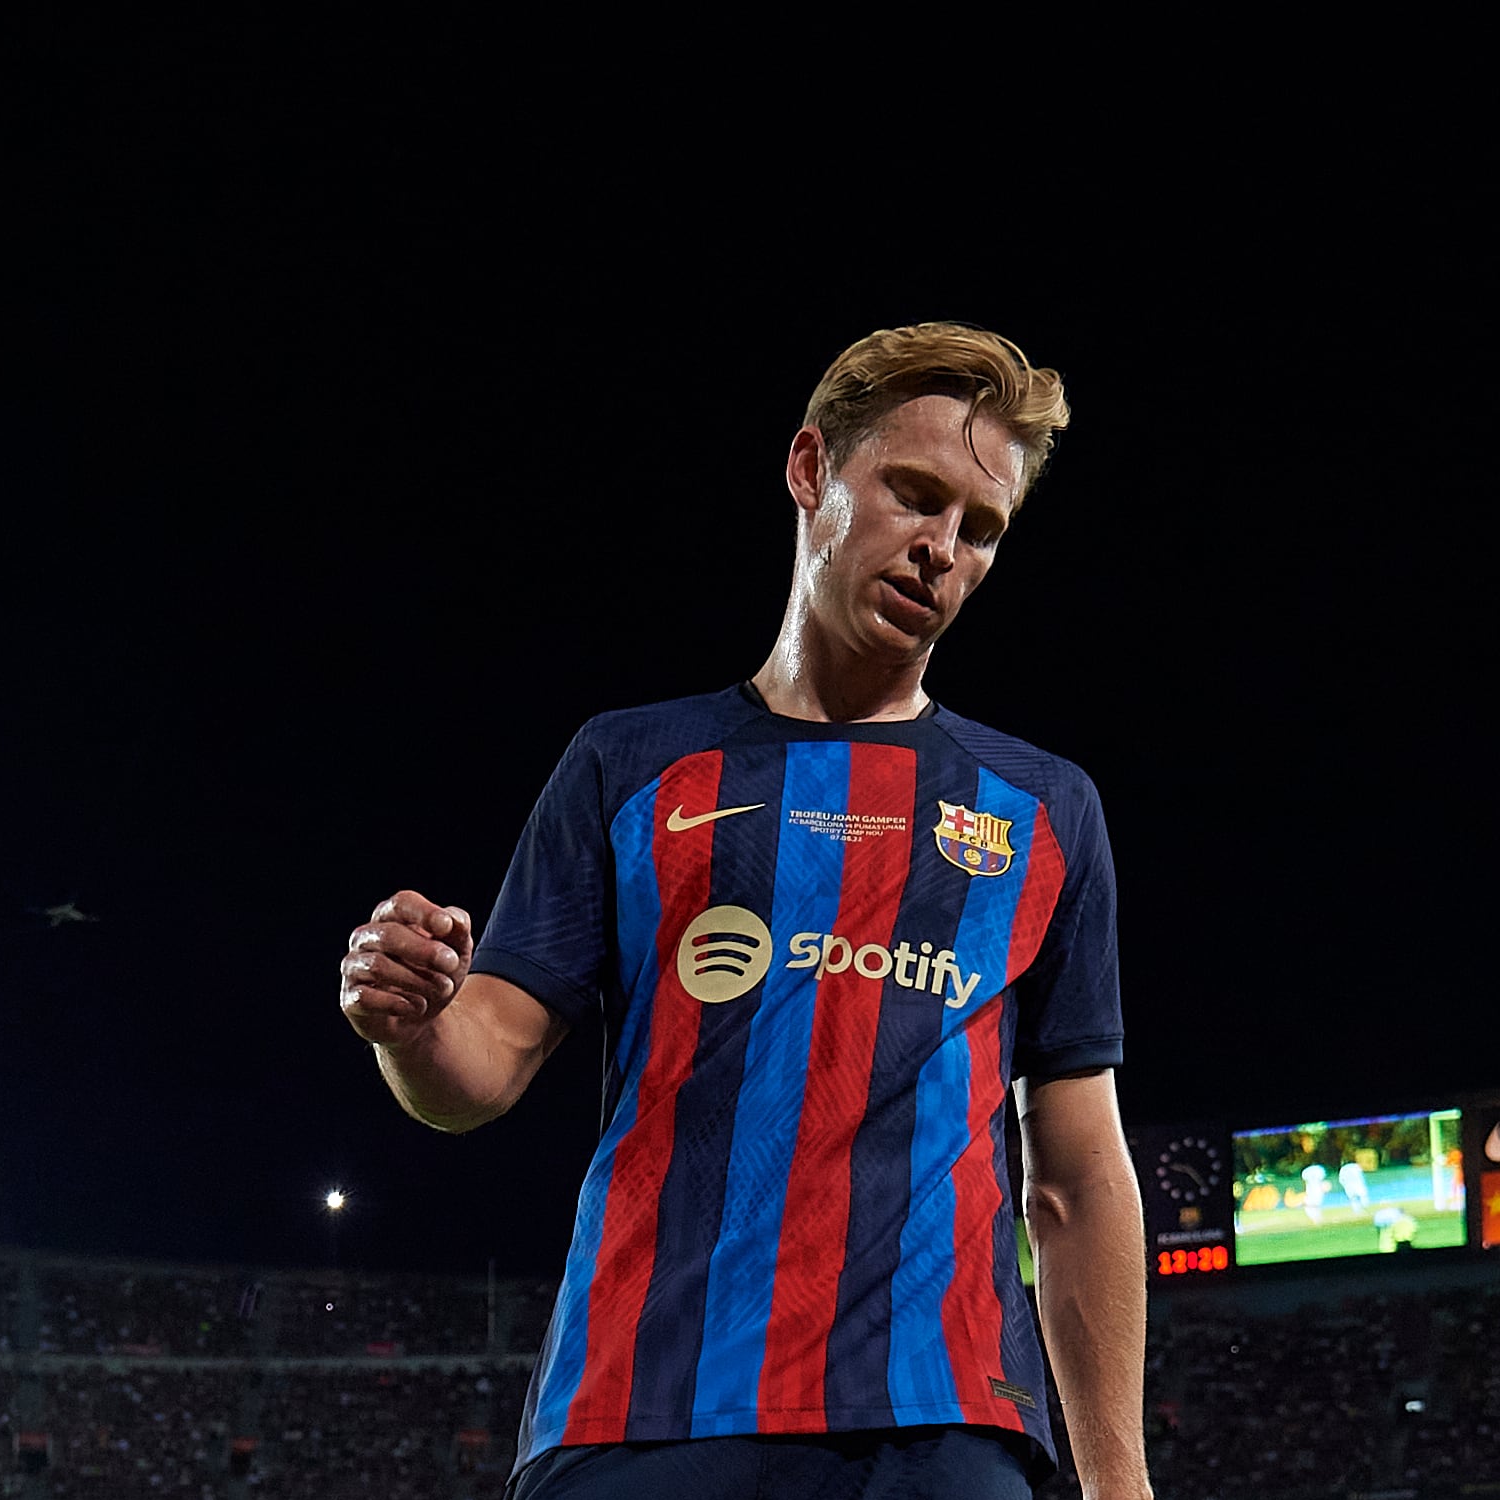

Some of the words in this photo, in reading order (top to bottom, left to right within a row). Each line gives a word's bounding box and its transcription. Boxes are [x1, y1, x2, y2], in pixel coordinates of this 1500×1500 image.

[789, 810, 831, 820] TROFEU
[832, 814, 860, 822] JOAN
[861, 815, 906, 823] GAMPER
[799, 818, 844, 828] BARCELONA
[810, 826, 842, 834] SPOTIFY
[785, 932, 982, 1009] spotify
